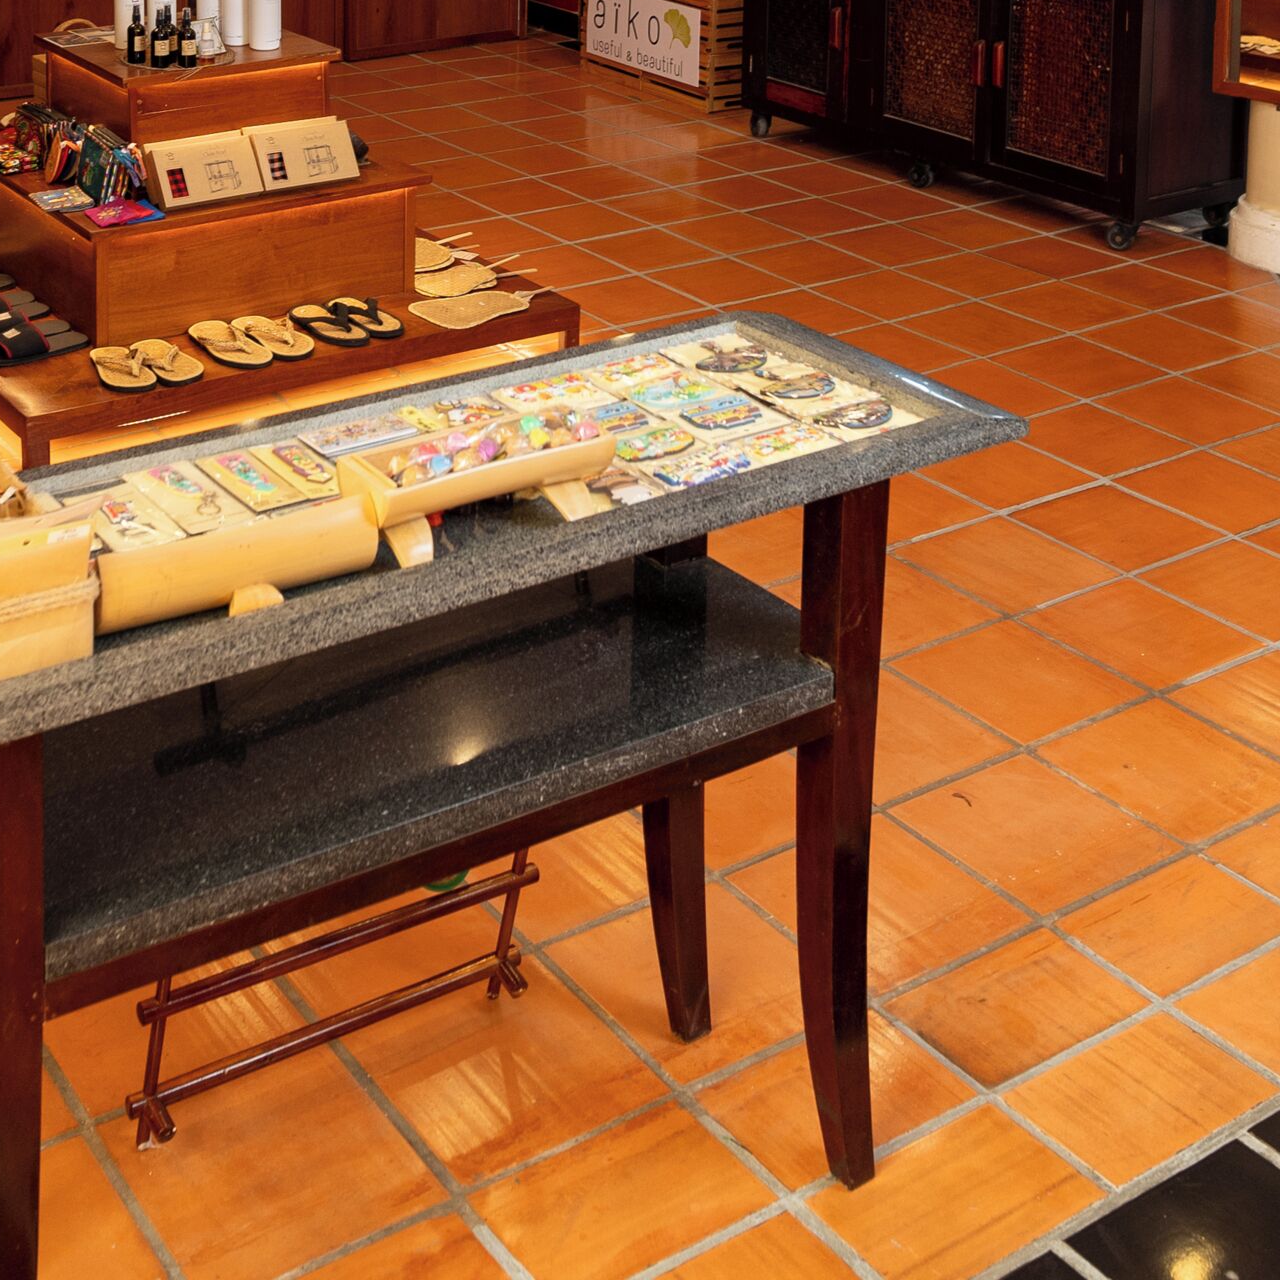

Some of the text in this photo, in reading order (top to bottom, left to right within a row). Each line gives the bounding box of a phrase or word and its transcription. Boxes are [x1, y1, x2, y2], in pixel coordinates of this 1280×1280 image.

[593, 39, 683, 78] useful & beautiful
